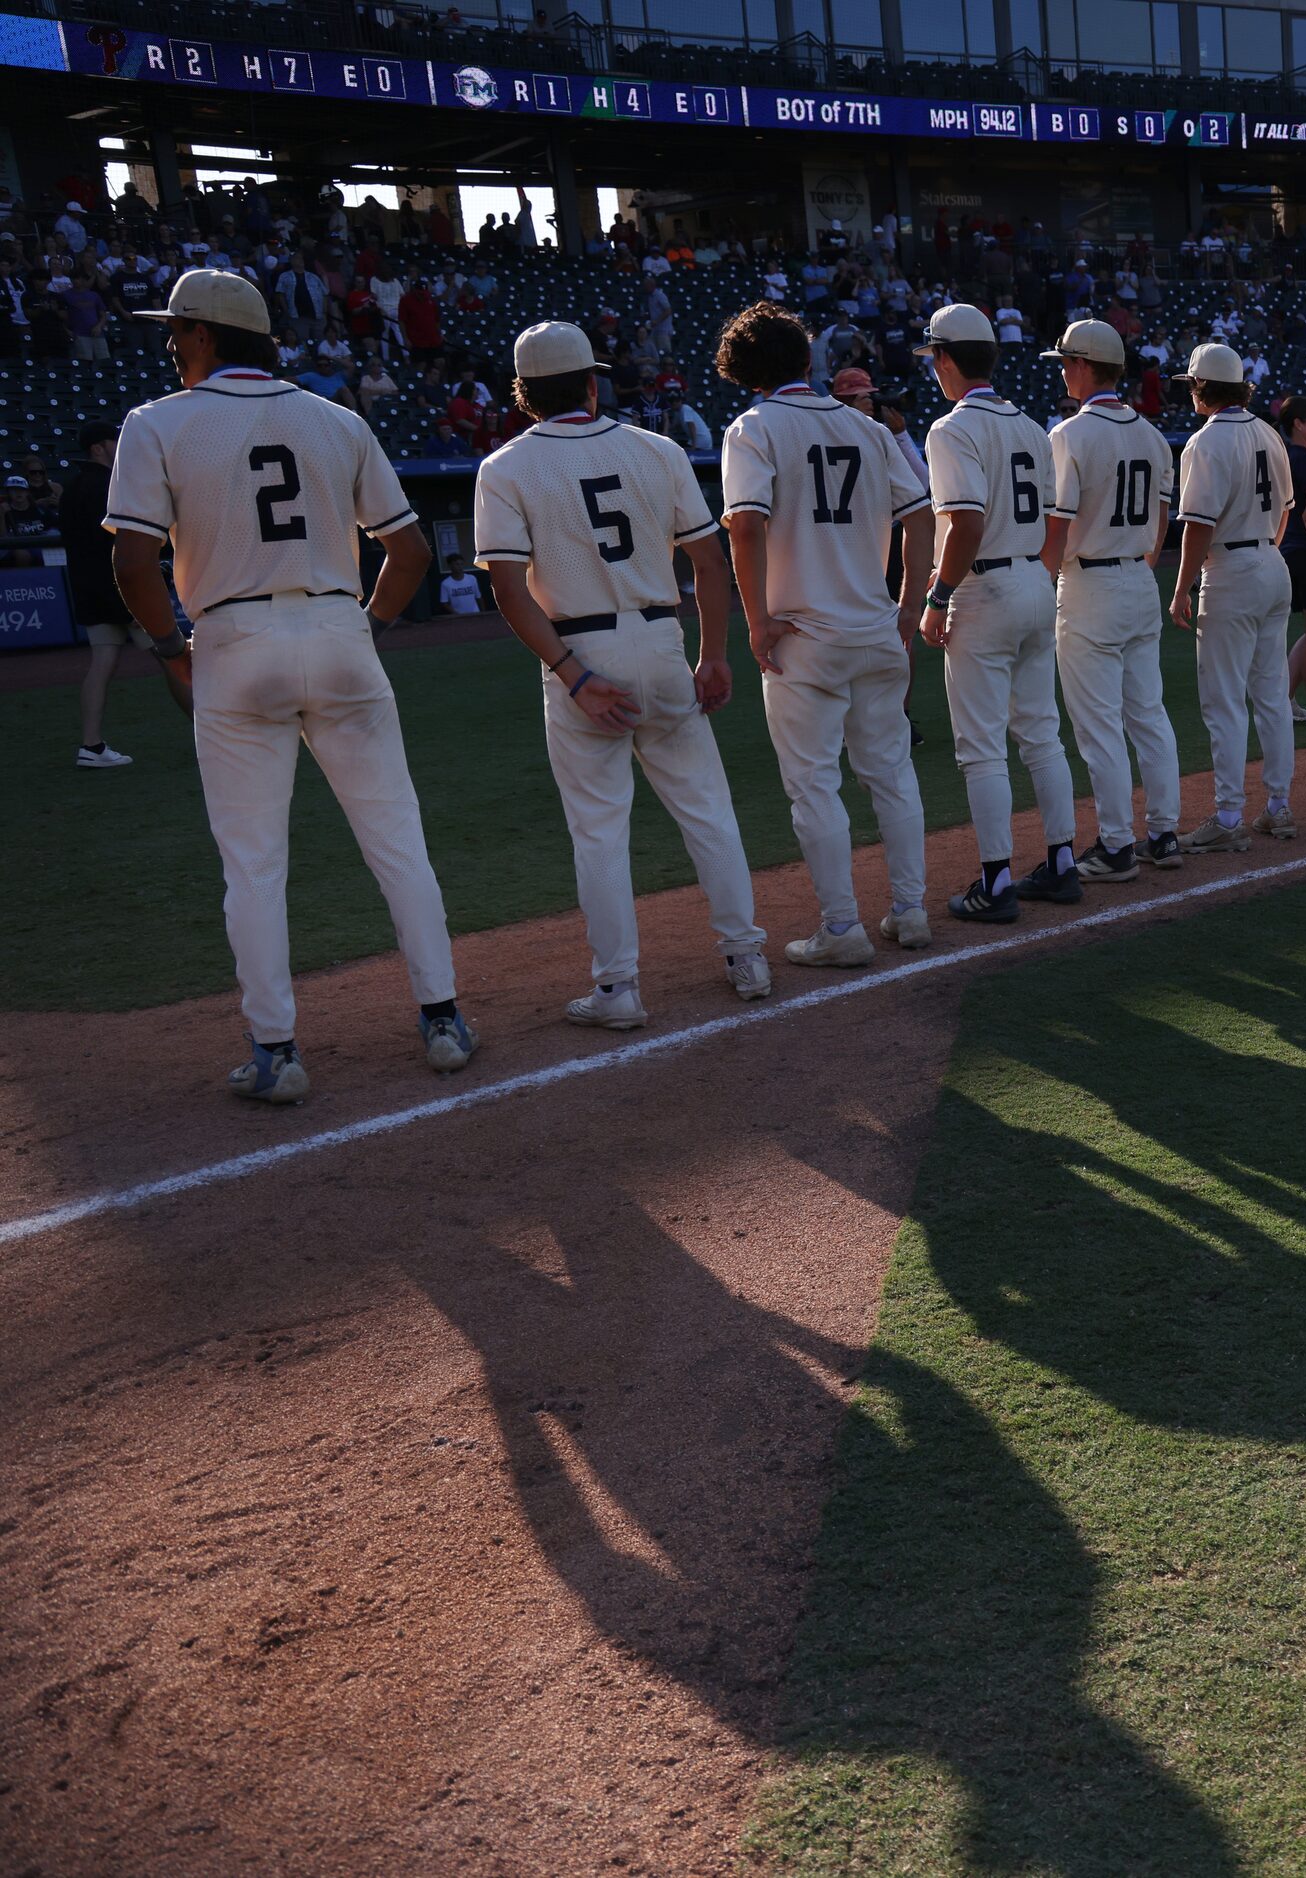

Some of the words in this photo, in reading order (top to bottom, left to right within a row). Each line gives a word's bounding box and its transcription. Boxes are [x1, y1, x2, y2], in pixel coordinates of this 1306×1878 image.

[147, 44, 165, 71] R
[186, 48, 202, 76] 2
[243, 55, 262, 79] H
[284, 57, 298, 84] 7
[344, 65, 359, 88] E
[378, 66, 391, 92] 0
[514, 80, 529, 102] R
[548, 82, 558, 106] 1
[593, 87, 608, 108] H
[626, 88, 640, 112] 4
[676, 92, 689, 113] E
[705, 93, 716, 116] 0
[777, 98, 817, 122] BOT
[821, 101, 841, 123] of
[845, 103, 881, 126] 7TH
[930, 109, 968, 130] MPH
[1052, 114, 1064, 132] B
[1079, 115, 1089, 135] 0
[1117, 116, 1128, 135] S
[1144, 117, 1155, 137] 0
[1184, 119, 1195, 138] O
[1209, 119, 1219, 140] 2
[1254, 123, 1268, 138] IT
[1268, 124, 1289, 140] ALL
[809, 190, 843, 204] TONY
[920, 188, 983, 208] Statesman
[248, 444, 307, 543] 2
[807, 444, 861, 524] 17
[1010, 451, 1039, 524] 6
[1110, 459, 1152, 527] 10
[1255, 450, 1272, 512] 4
[579, 474, 635, 563] 5
[5, 586, 57, 603] REPAIRS
